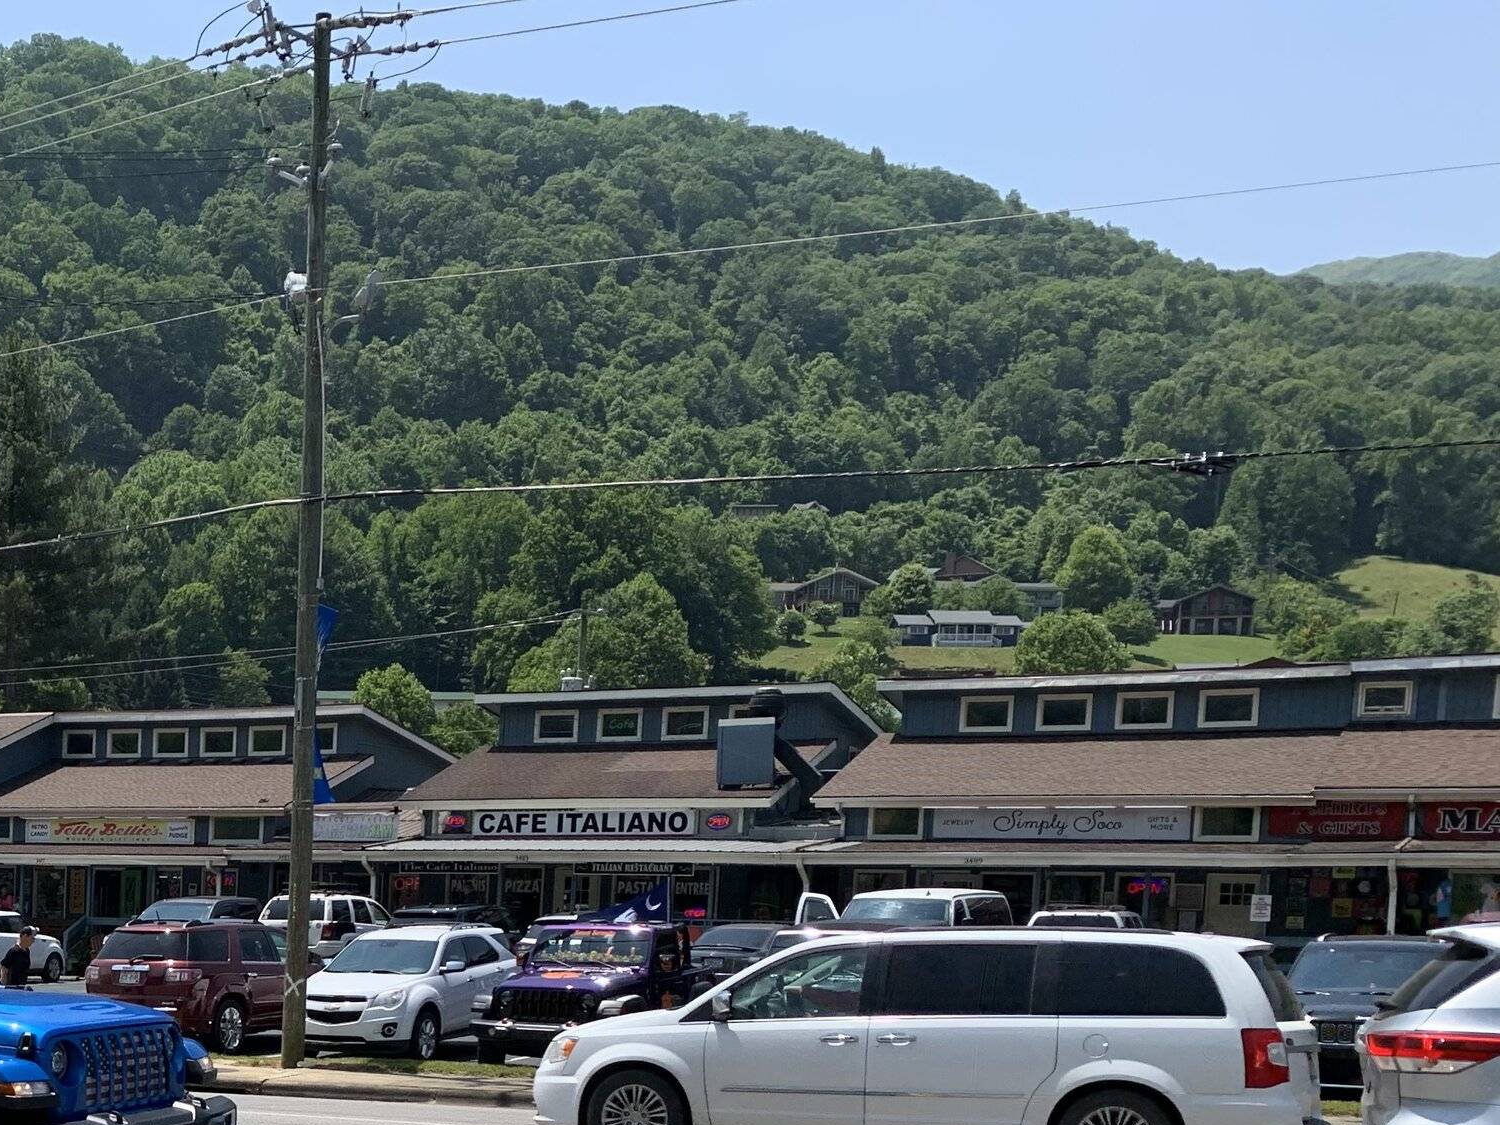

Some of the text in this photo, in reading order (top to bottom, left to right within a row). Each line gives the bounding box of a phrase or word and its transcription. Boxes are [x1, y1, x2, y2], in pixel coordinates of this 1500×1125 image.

[55, 821, 98, 837] Jelly
[478, 812, 689, 834] CAFE ITALIANO
[708, 816, 730, 828] OPEN
[993, 810, 1123, 836] Simply Soco
[1298, 821, 1381, 835] & GIFTS
[592, 862, 675, 873] ITALIAN RESTAURANT
[504, 879, 541, 893] PIZZA
[1126, 881, 1162, 894] OPN
